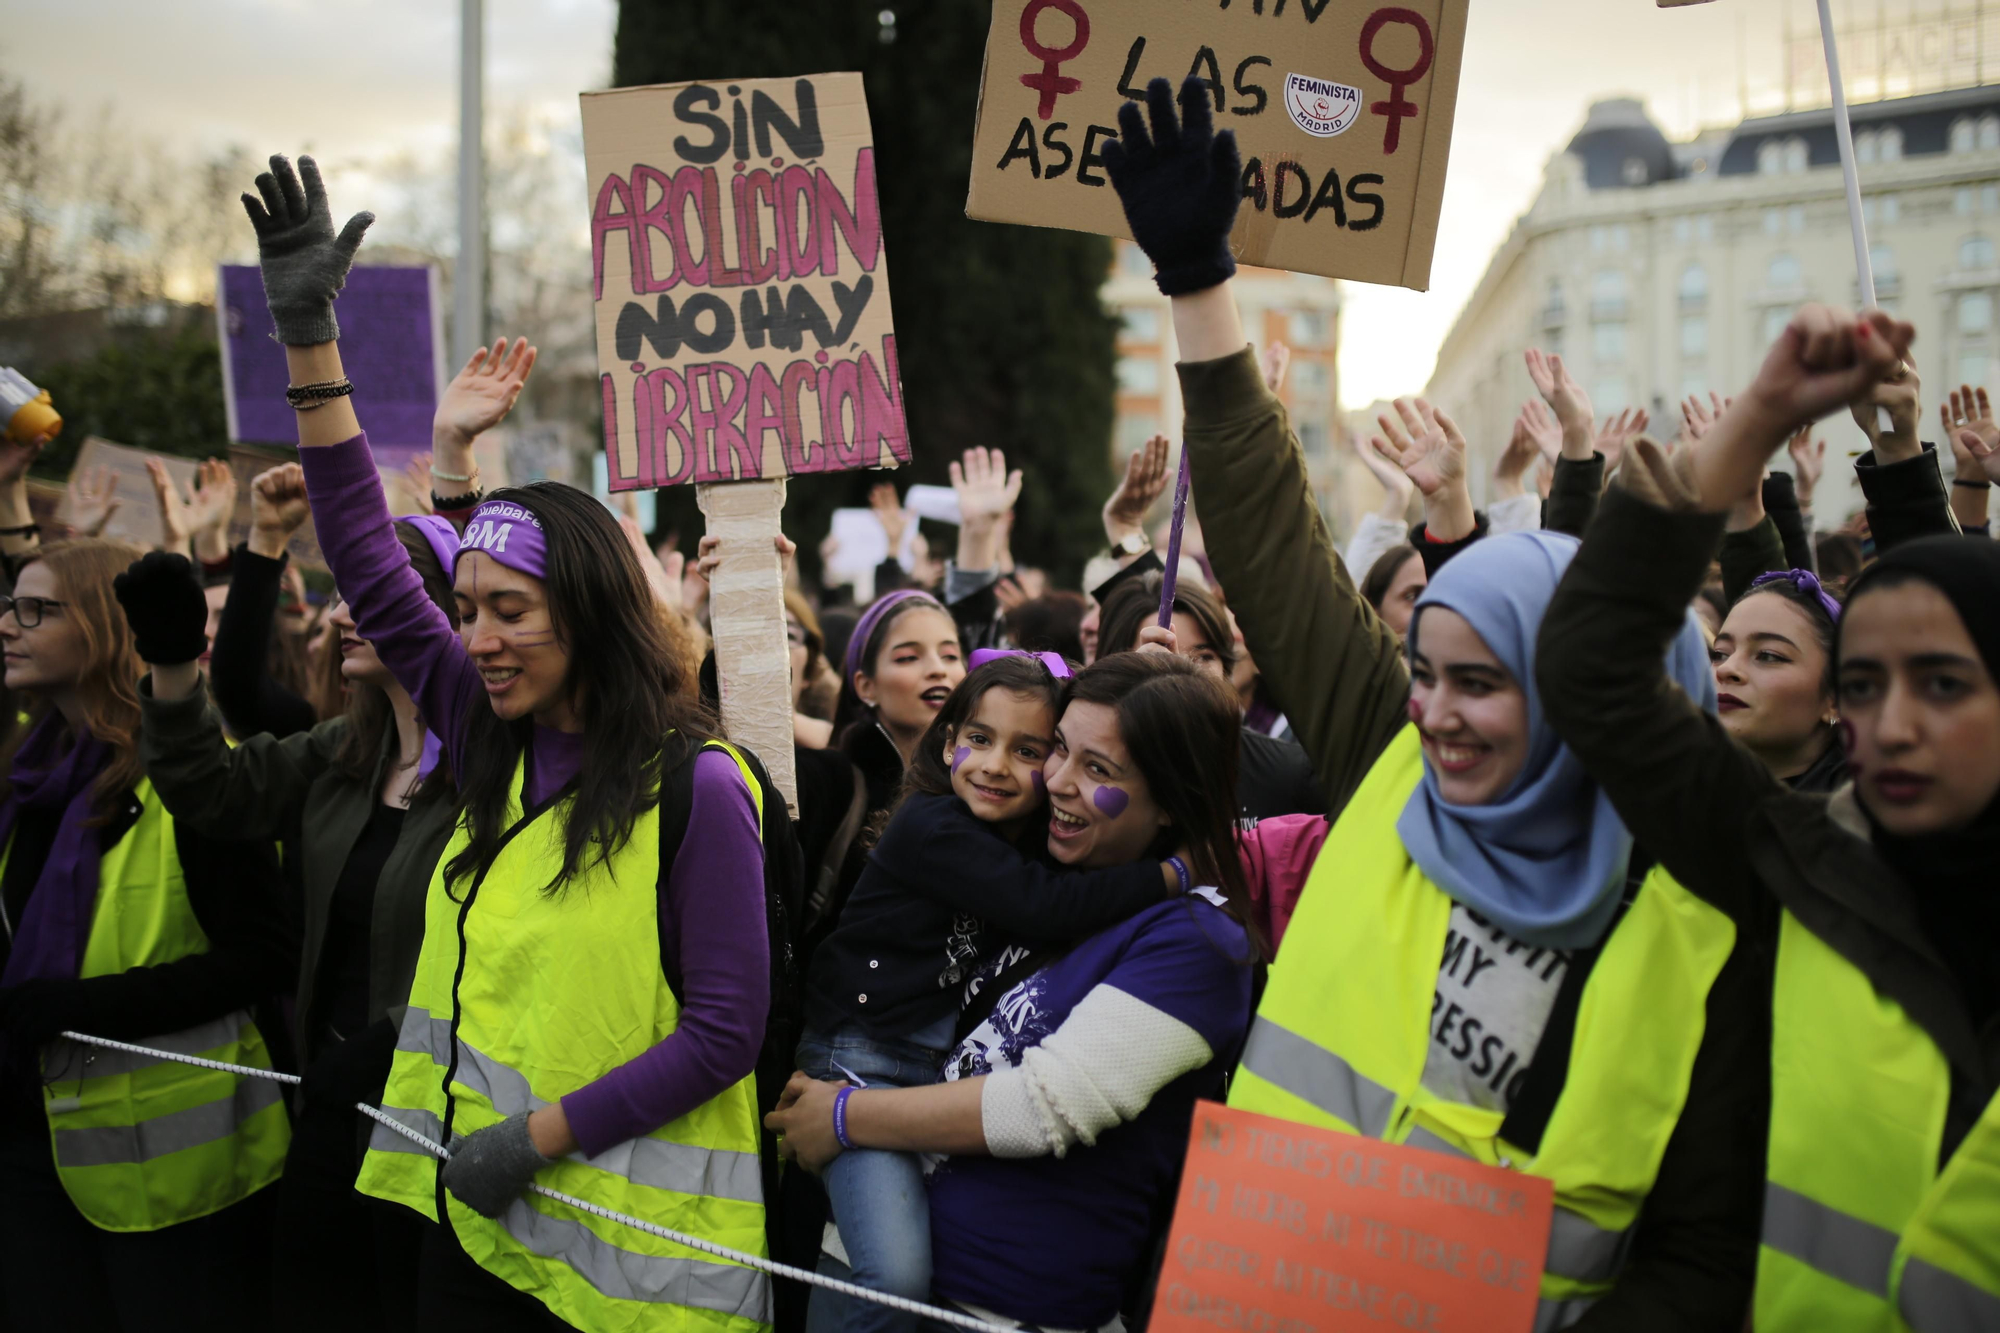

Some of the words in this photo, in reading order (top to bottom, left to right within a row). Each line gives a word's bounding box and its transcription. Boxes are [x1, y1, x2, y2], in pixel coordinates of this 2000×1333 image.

[1117, 36, 1272, 116] LAS
[1290, 76, 1357, 103] FEMINISTA
[1297, 111, 1342, 132] MADRID
[997, 117, 1385, 231] ASEADAS
[615, 291, 736, 361] NO
[740, 274, 874, 353] HAY
[459, 520, 513, 553] 8M
[1440, 928, 1497, 989] MY
[1201, 1117, 1236, 1157] NO
[1245, 1126, 1333, 1179] TIENES
[1337, 1150, 1390, 1191] QUE
[1401, 1163, 1528, 1219] ENTENDER
[1322, 1209, 1352, 1249] NI
[1360, 1216, 1392, 1259] TE
[1400, 1227, 1469, 1279] TIENE
[1476, 1248, 1531, 1294] QUE
[1273, 1257, 1303, 1297] NI
[1309, 1265, 1388, 1322] TIENE
[1390, 1290, 1444, 1333] QUE
